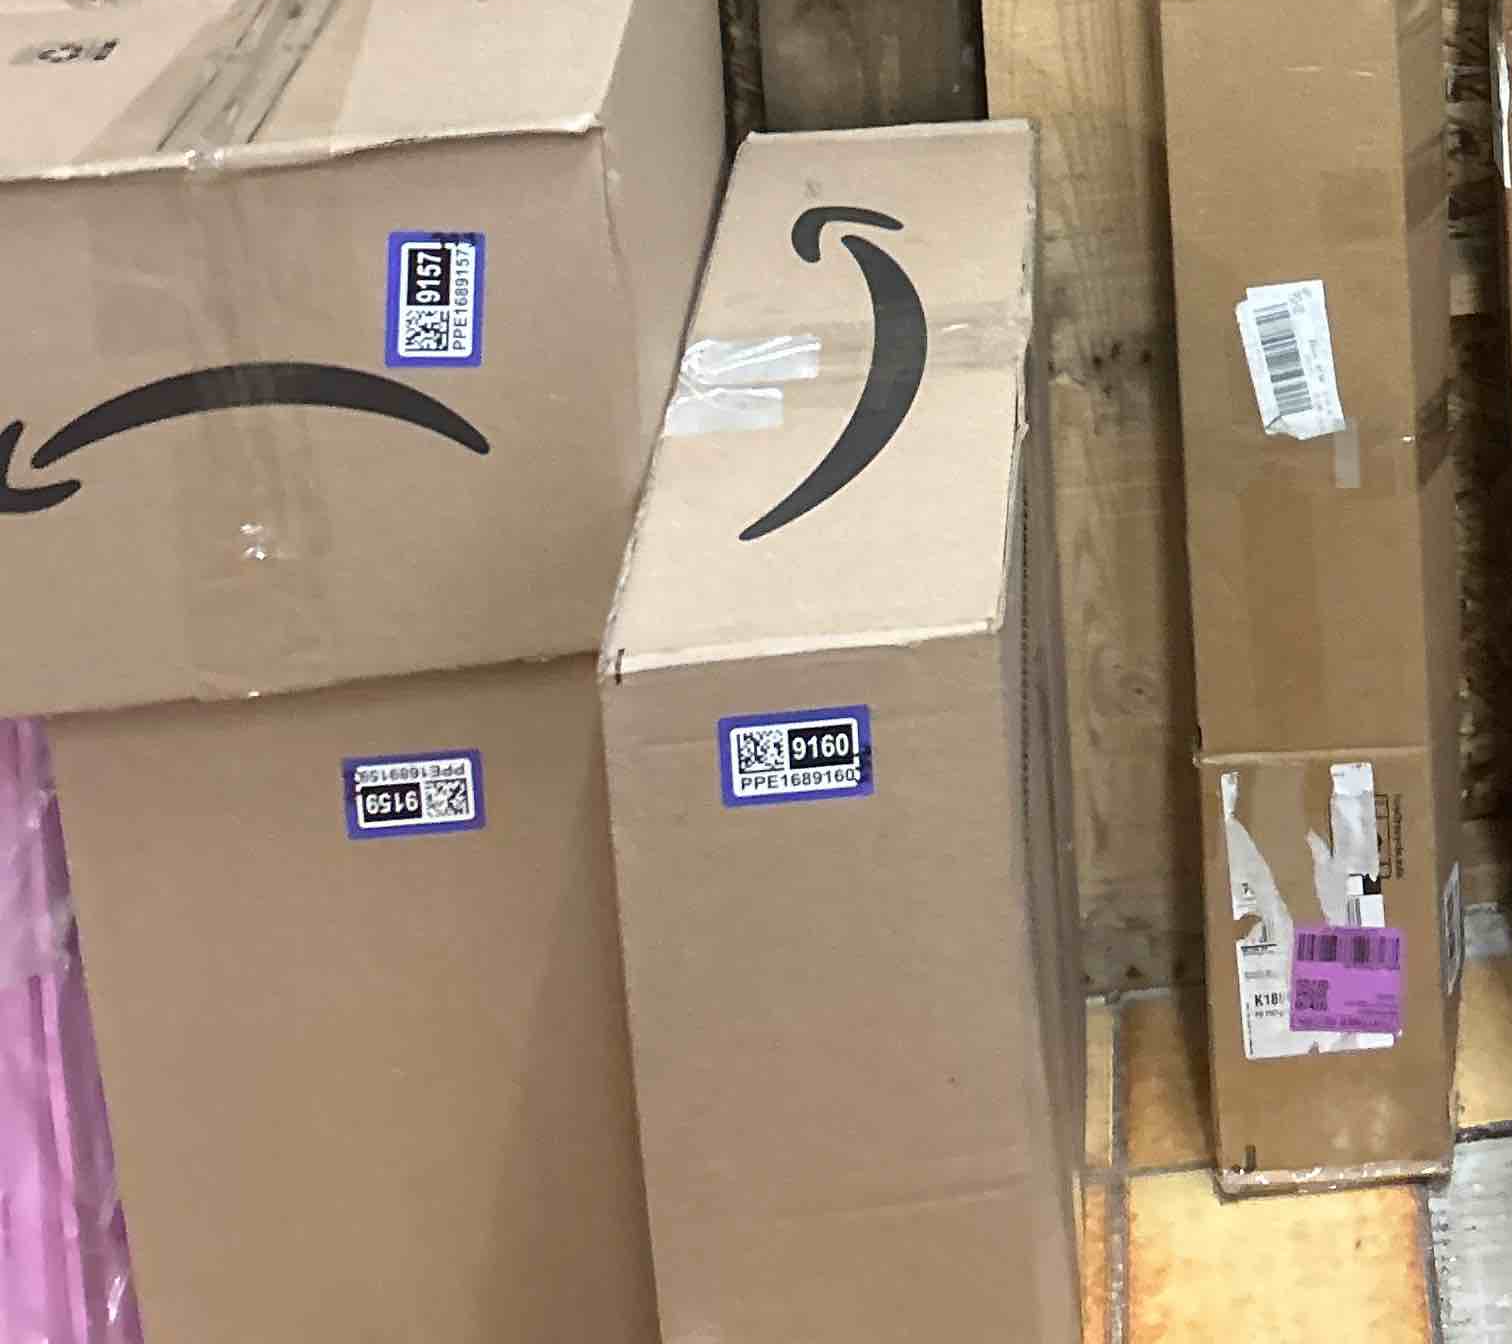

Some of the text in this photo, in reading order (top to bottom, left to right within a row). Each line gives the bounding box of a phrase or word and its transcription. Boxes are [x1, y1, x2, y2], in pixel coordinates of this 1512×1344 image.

[415, 251, 442, 304] 9157
[453, 246, 470, 351] PPE1689157
[791, 732, 850, 761] 9160
[741, 768, 856, 791] PPE1689160
[365, 790, 420, 815] 9159
